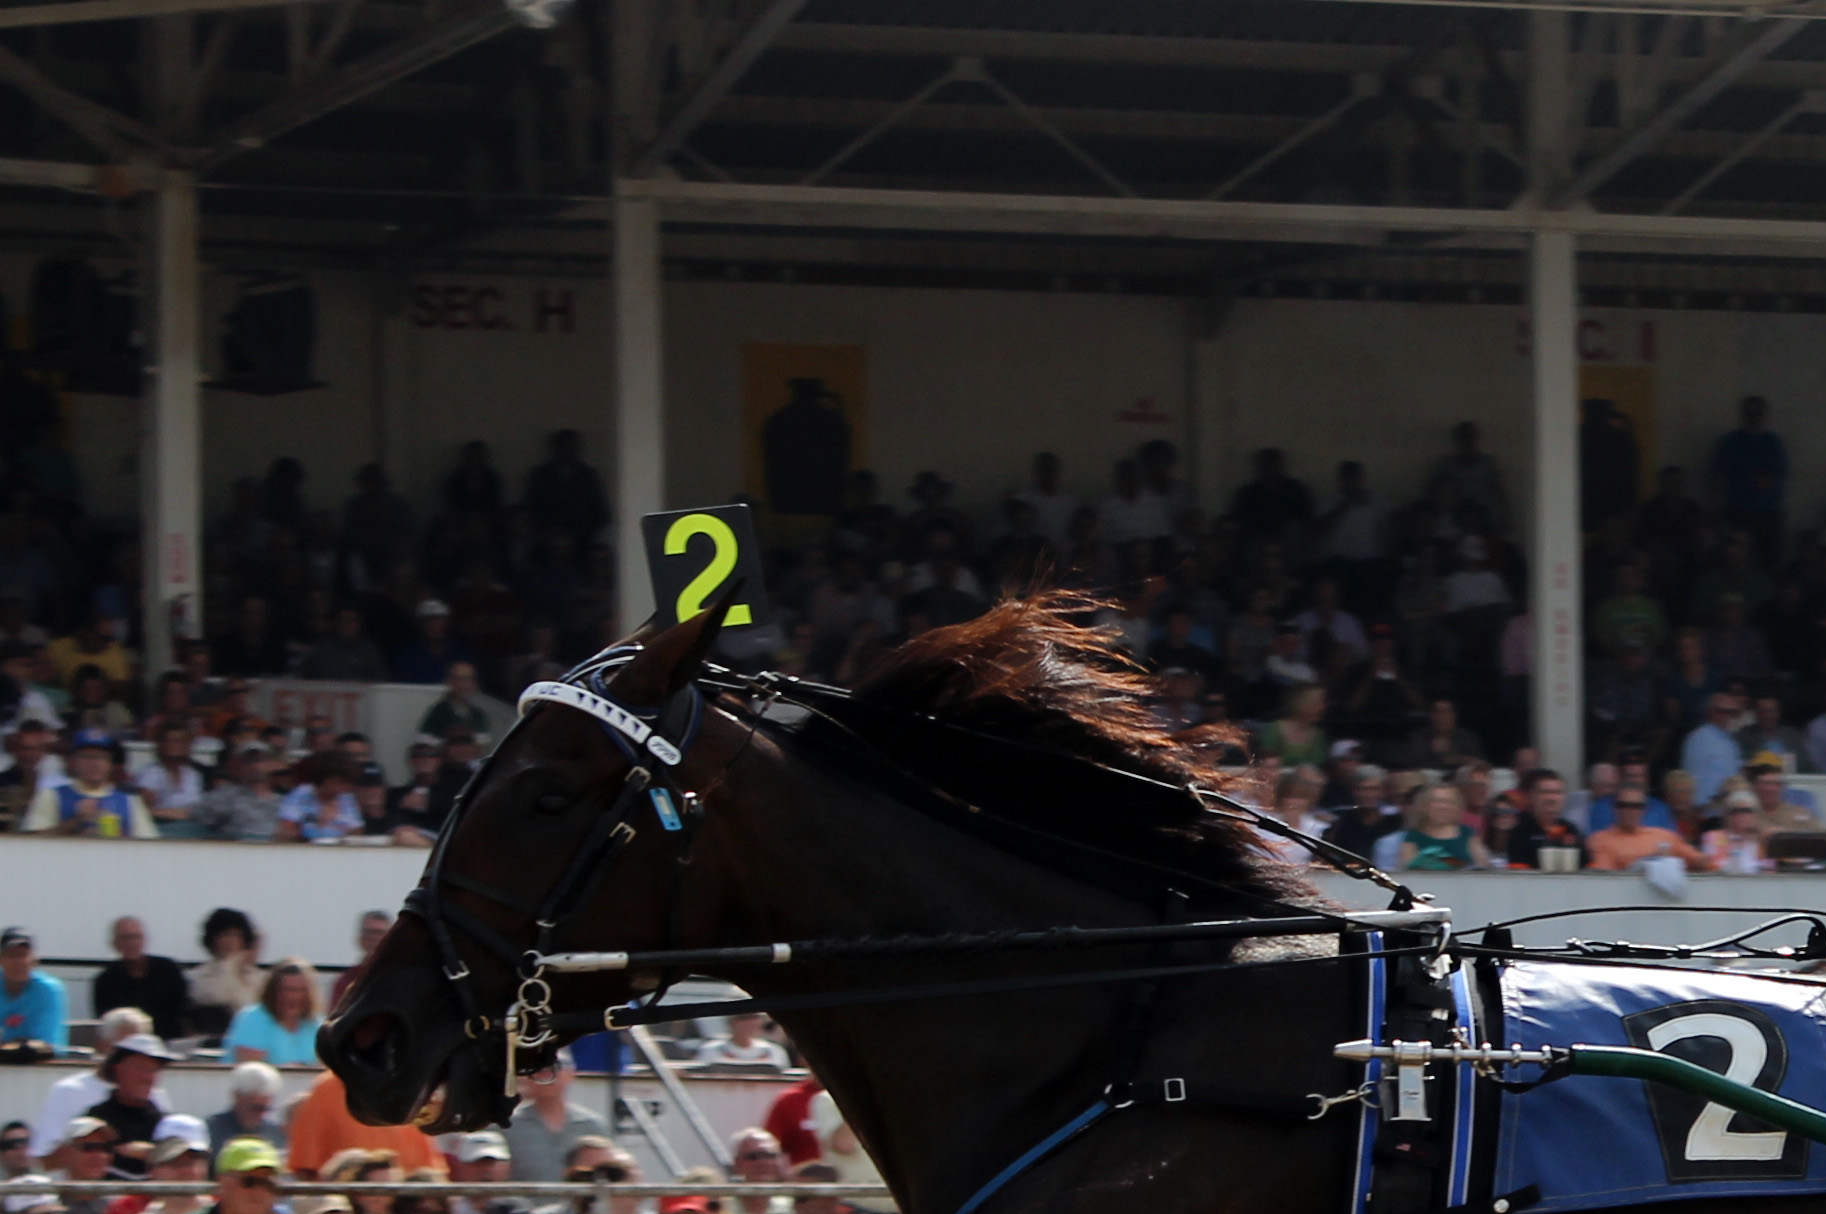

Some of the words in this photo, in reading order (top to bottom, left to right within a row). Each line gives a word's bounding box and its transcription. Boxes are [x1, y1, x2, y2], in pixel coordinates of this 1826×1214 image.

[412, 284, 513, 330] SEC.
[535, 290, 575, 333] H
[663, 512, 754, 628] 2
[1646, 1012, 1789, 1161] 2
